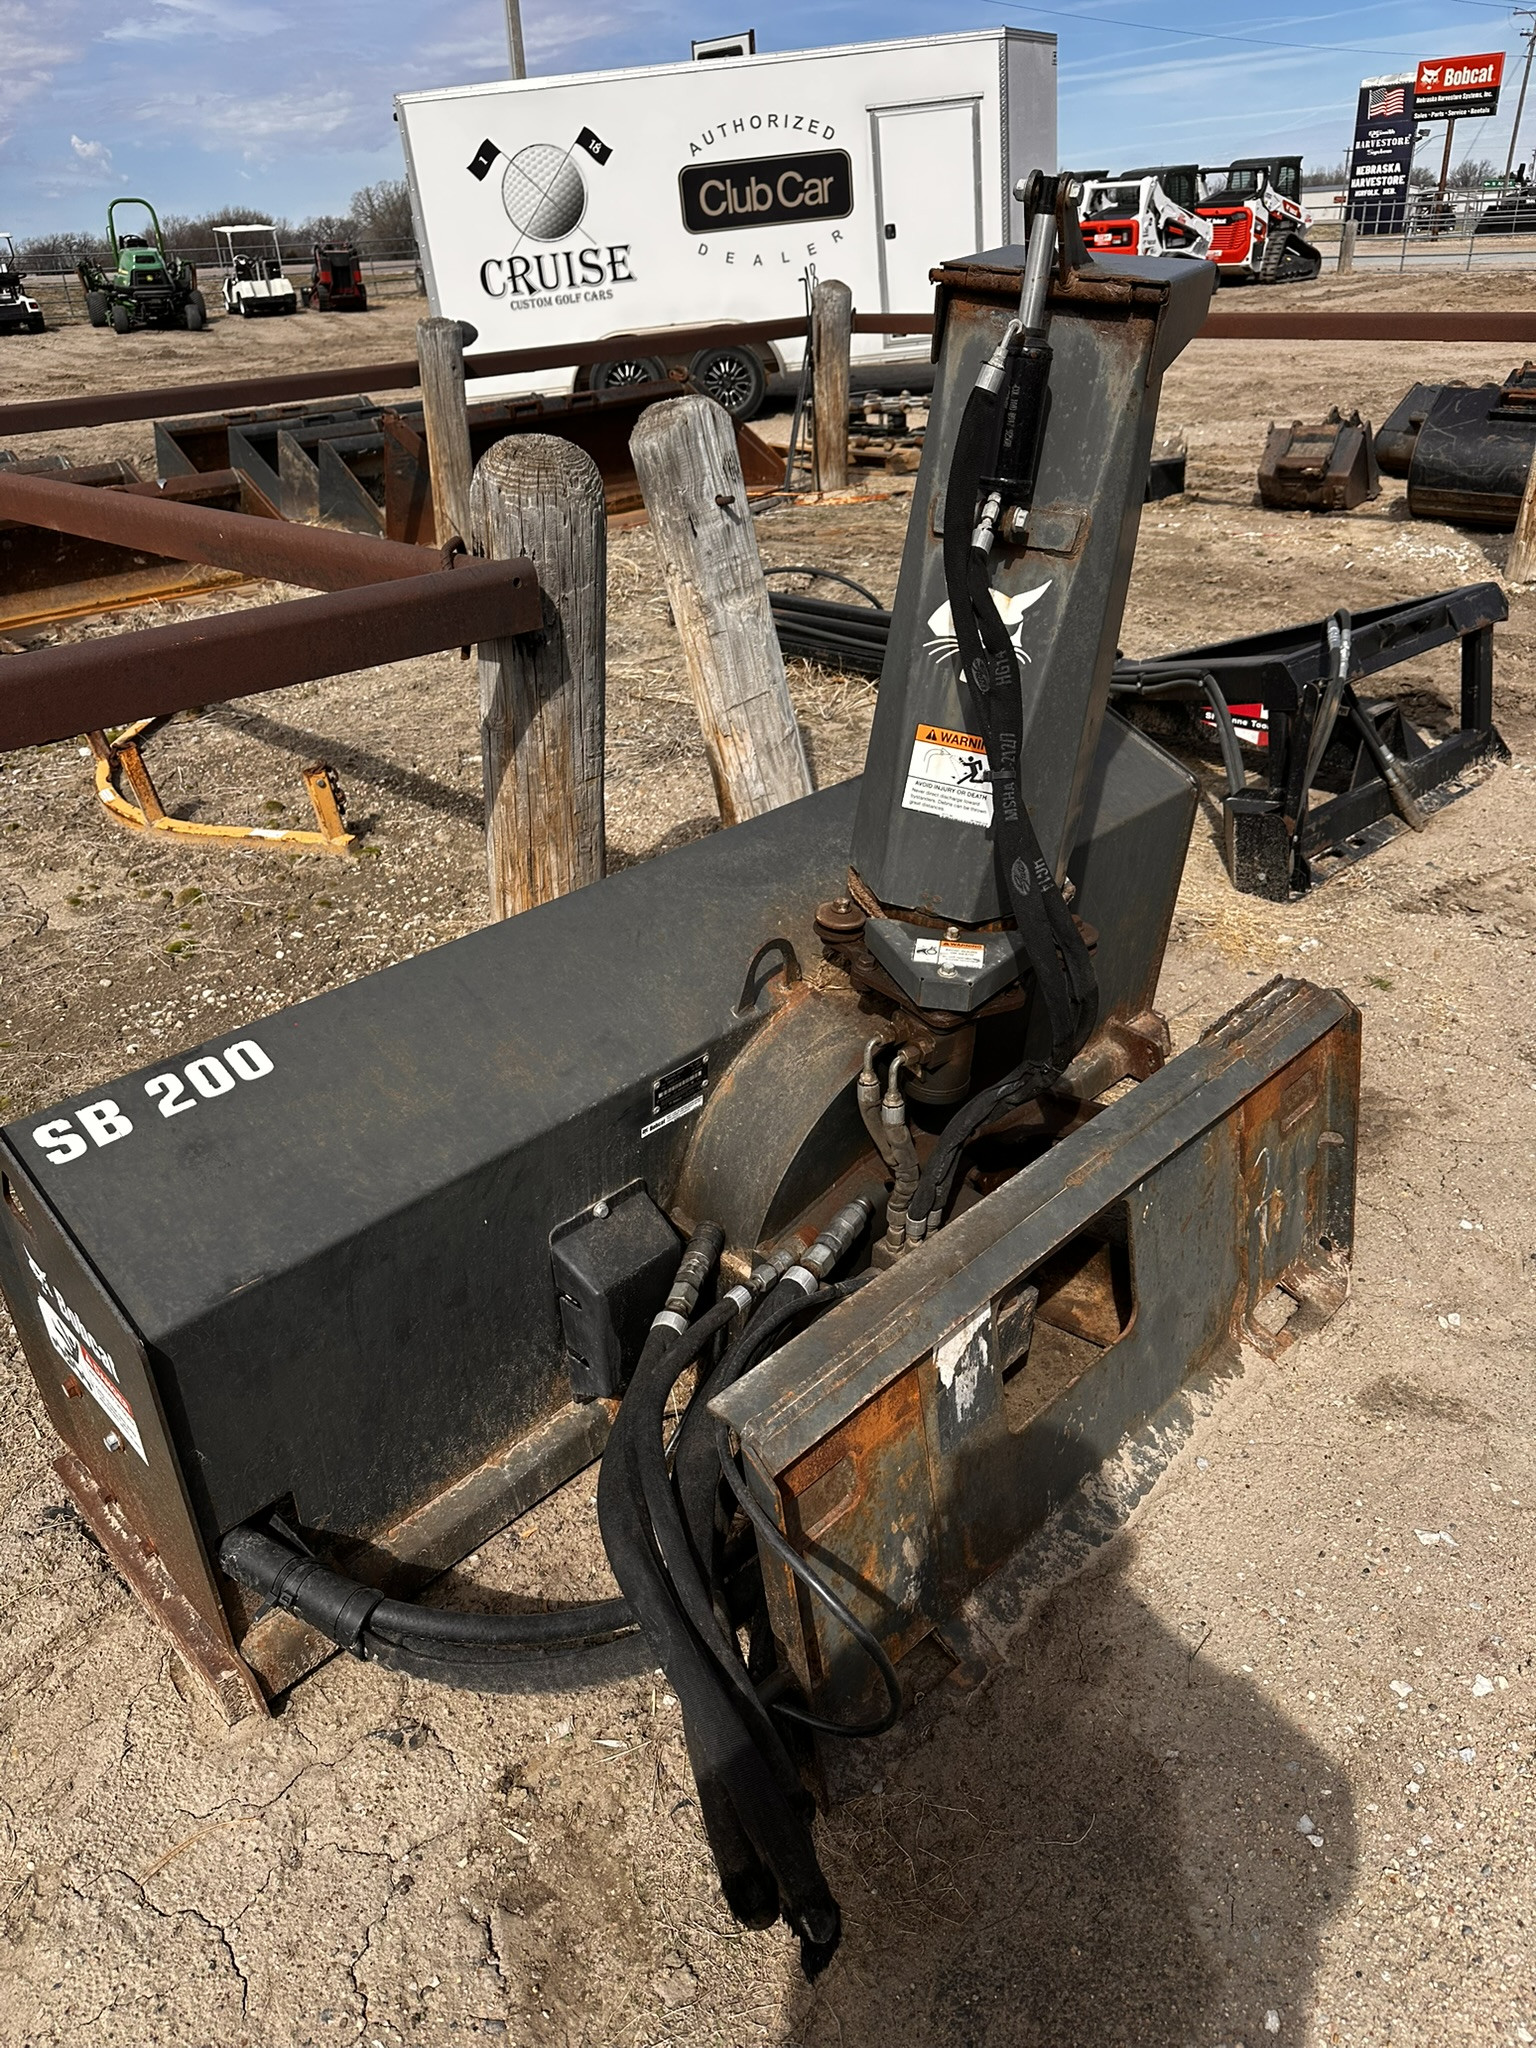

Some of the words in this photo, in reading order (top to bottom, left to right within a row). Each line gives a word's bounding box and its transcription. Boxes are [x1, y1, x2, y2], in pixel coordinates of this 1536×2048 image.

[1443, 64, 1494, 87] Bobcat
[1416, 95, 1437, 104] Nebraska
[1413, 112, 1428, 120] Sales
[1430, 110, 1444, 118] Parts
[1447, 108, 1467, 117] Service
[1470, 107, 1490, 115] Rentals
[689, 113, 836, 156] AUTHORIZED
[588, 138, 602, 155] 18
[478, 154, 489, 167] 1
[1356, 162, 1401, 176] NEBRASKA
[1351, 174, 1406, 188] HARVESTORE
[699, 174, 773, 217] Club
[776, 170, 834, 208] Car
[697, 229, 844, 267] DEALER
[479, 243, 637, 300] CRUISE
[510, 297, 552, 311] CUSTOM
[554, 292, 582, 306] GOLF
[584, 289, 614, 303] CARS
[941, 731, 985, 750] WARNI
[915, 780, 933, 789] AVOID
[934, 784, 957, 795] INJURY
[967, 791, 988, 800] DEATH
[1002, 782, 1019, 822] MSHA
[32, 1099, 134, 1165] SB
[144, 1039, 275, 1119] 200
[52, 1285, 120, 1384] Bobcat
